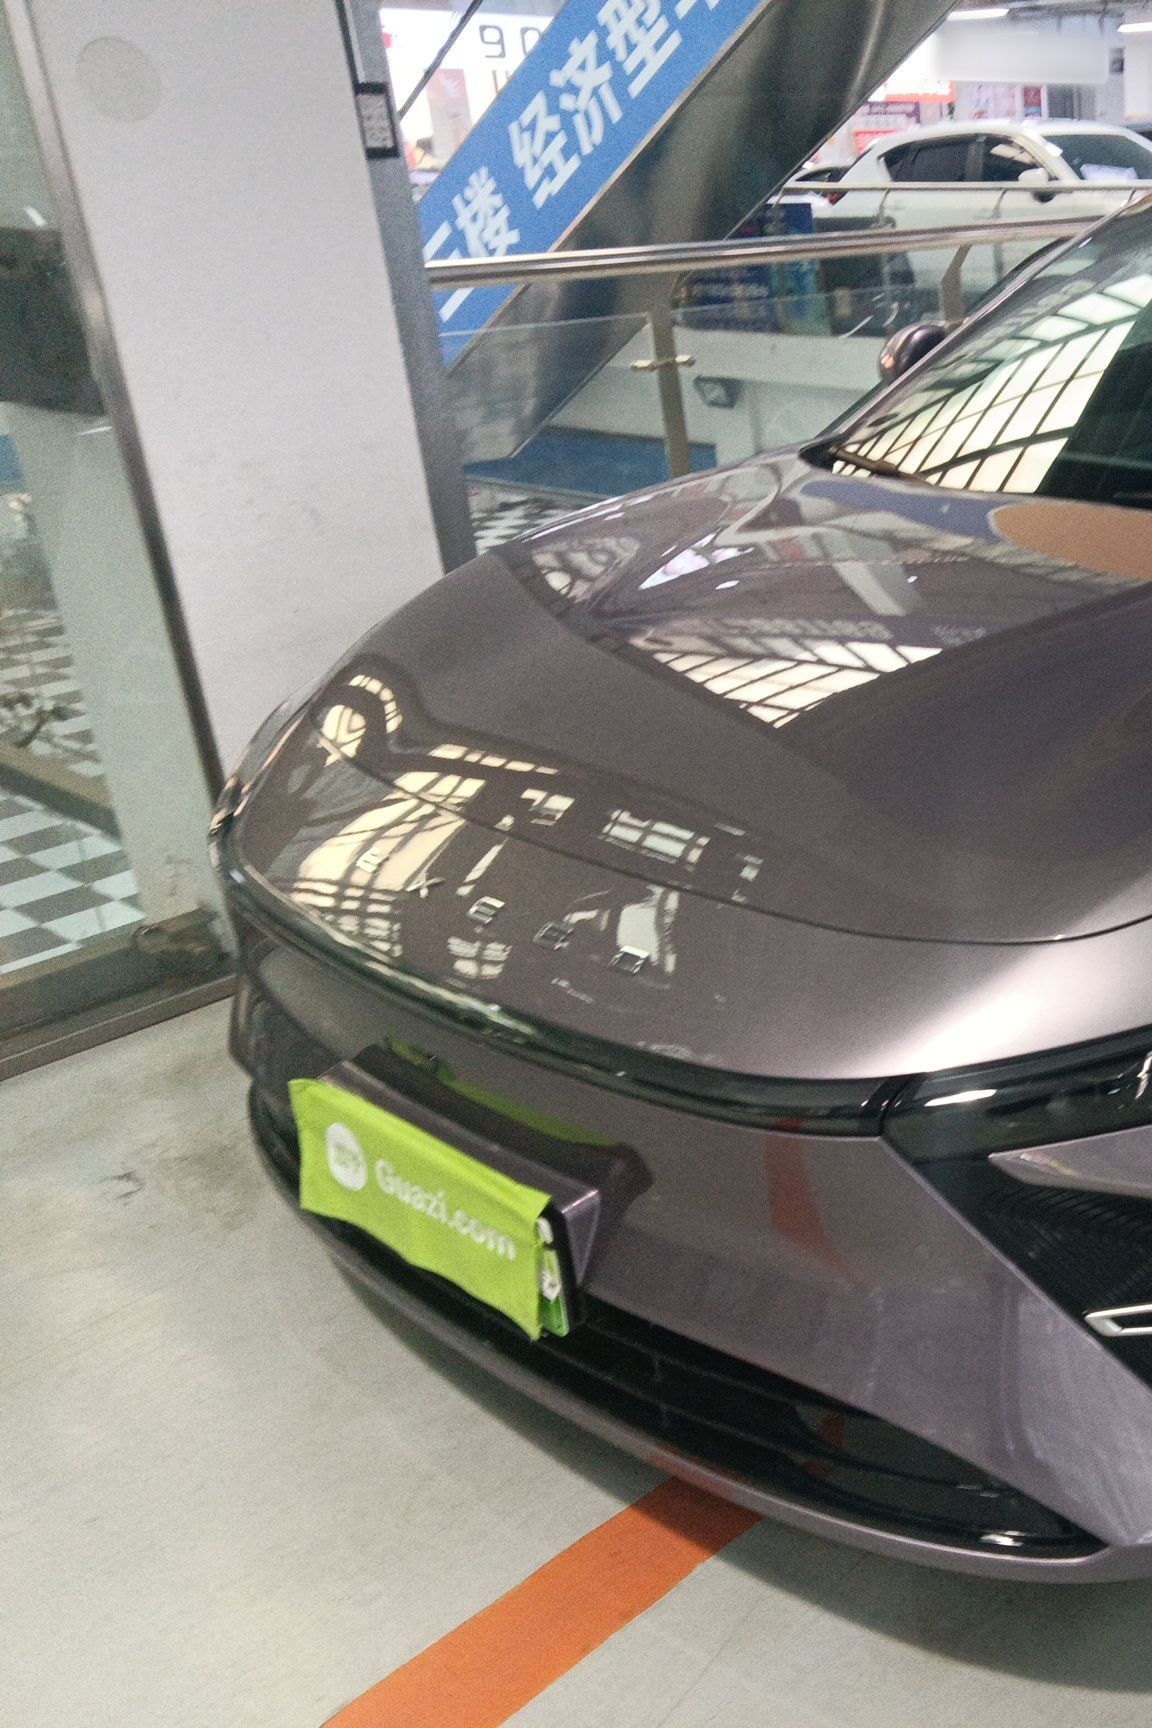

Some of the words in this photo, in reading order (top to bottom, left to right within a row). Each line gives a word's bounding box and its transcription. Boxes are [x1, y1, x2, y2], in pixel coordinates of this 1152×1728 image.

[508, 0, 723, 210] 经济型
[374, 1158, 517, 1261] Guazi.com
